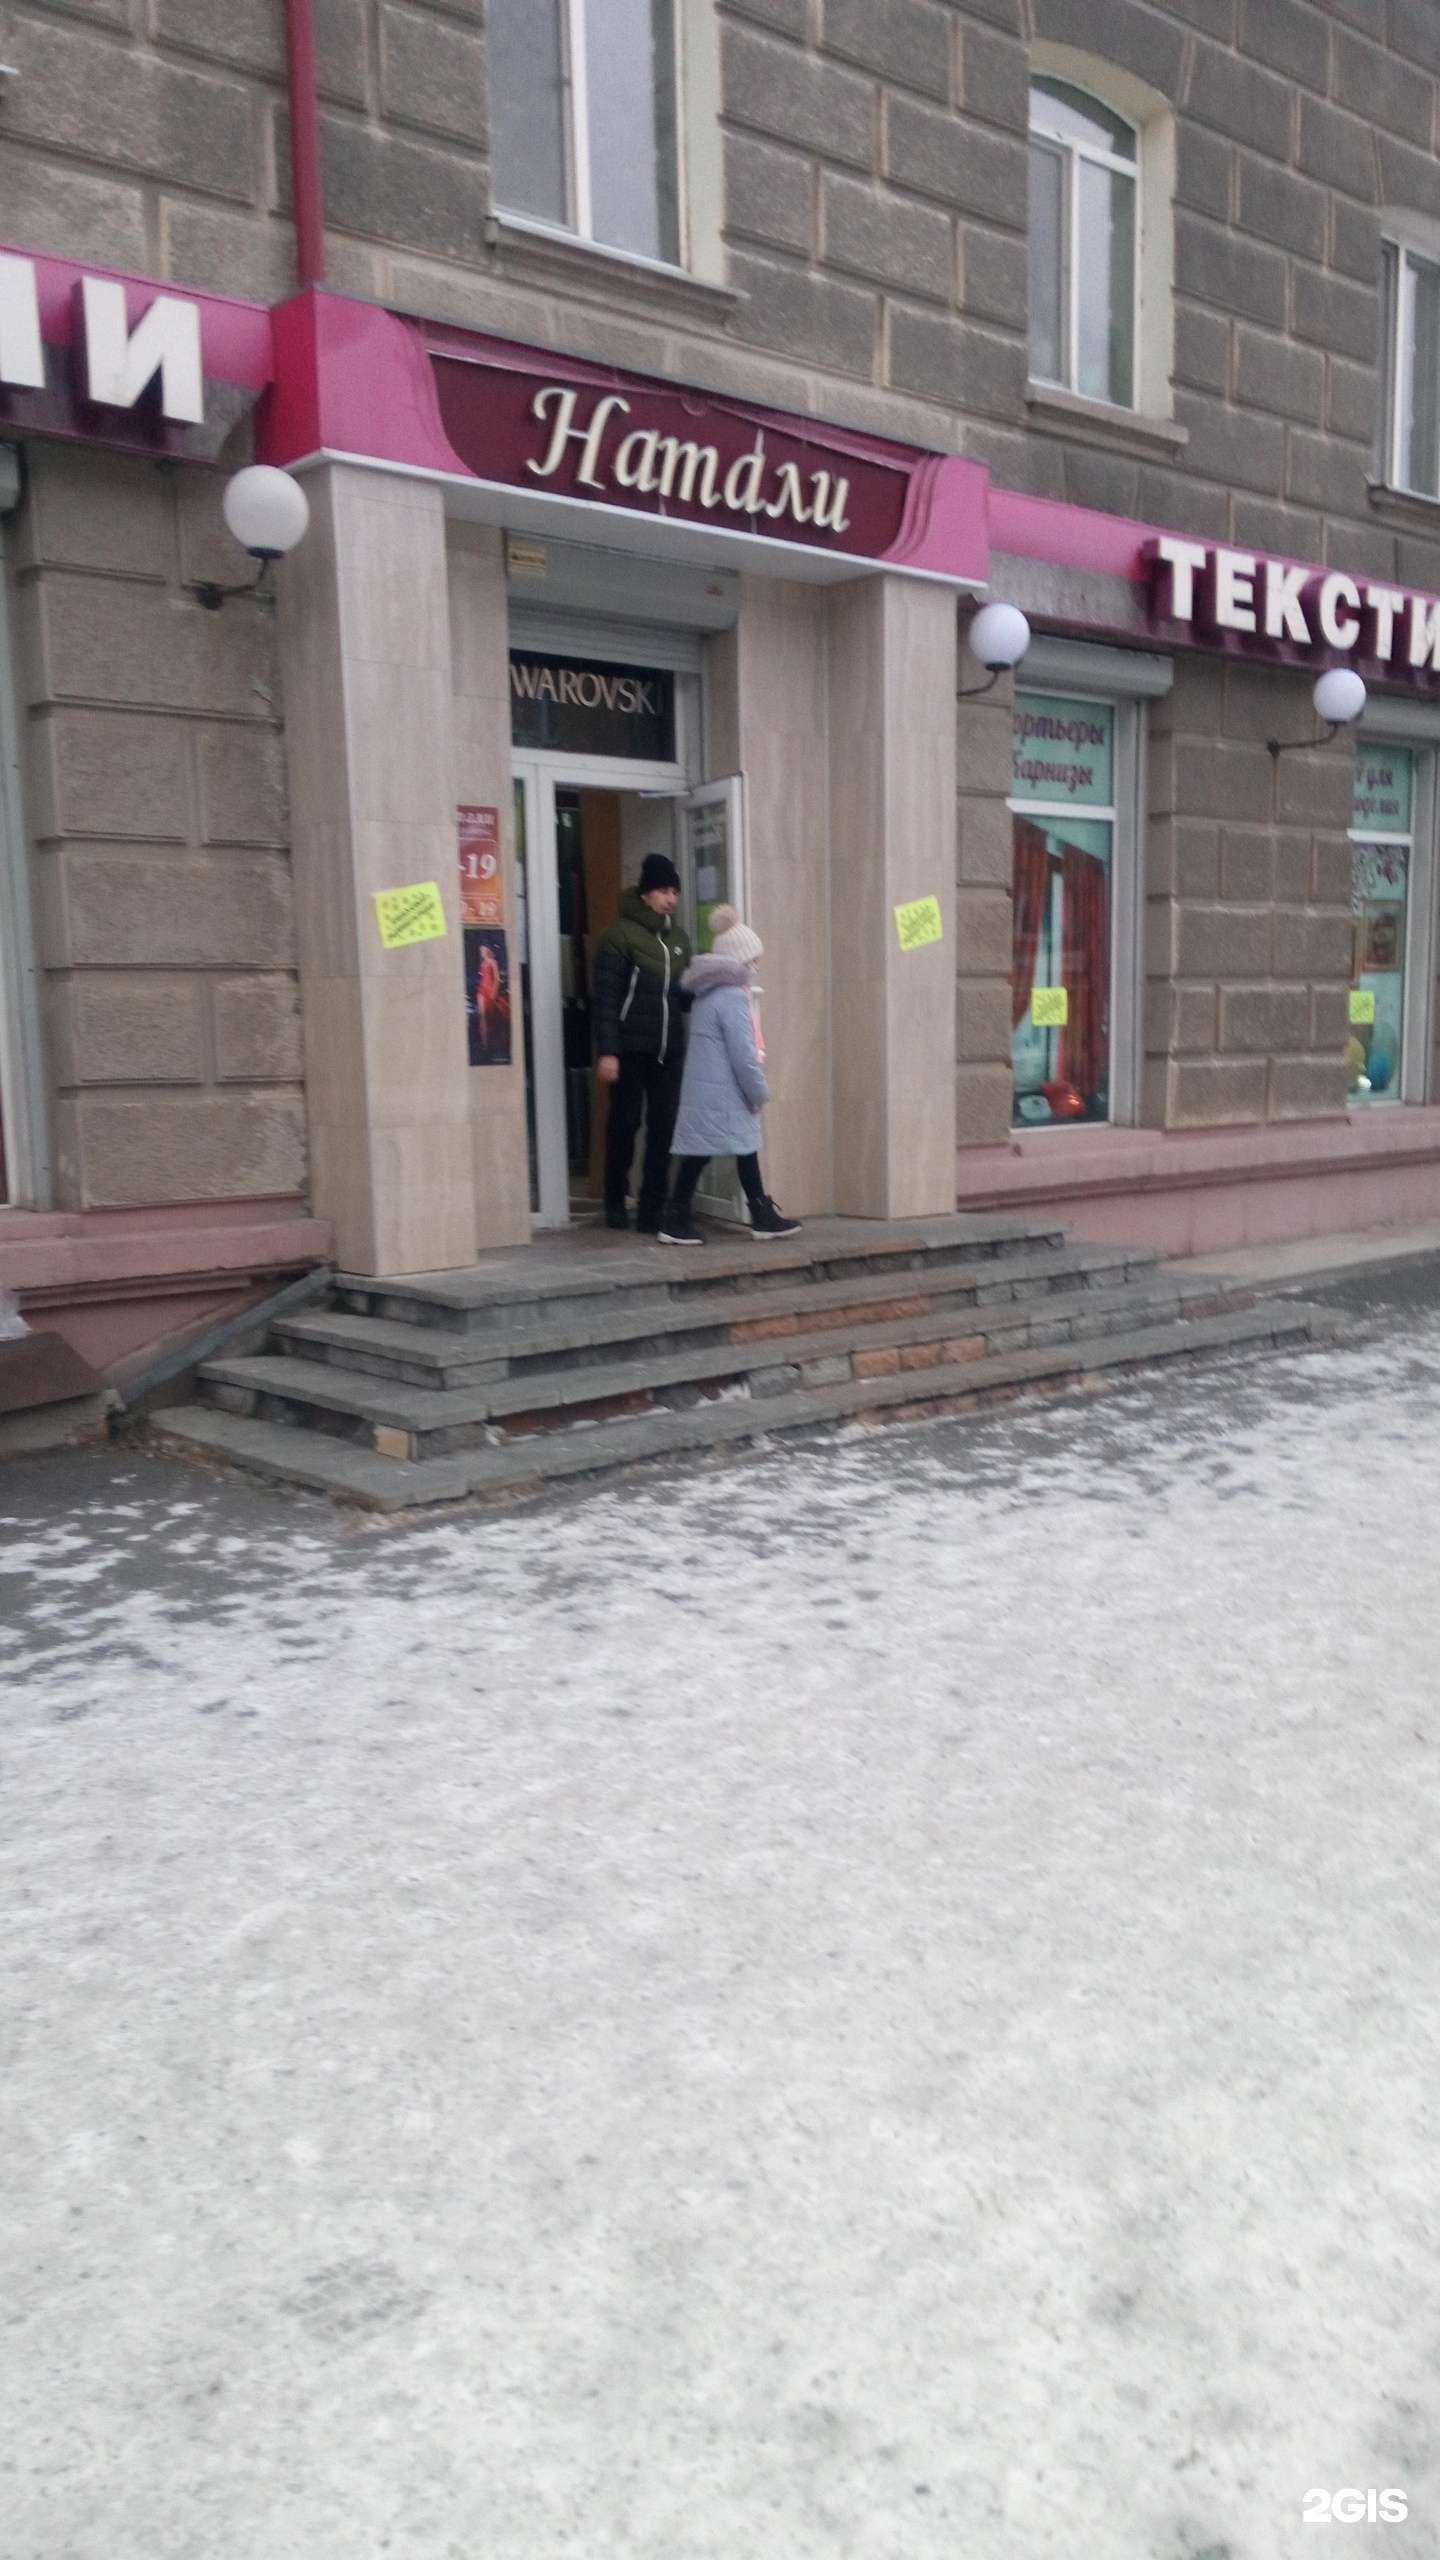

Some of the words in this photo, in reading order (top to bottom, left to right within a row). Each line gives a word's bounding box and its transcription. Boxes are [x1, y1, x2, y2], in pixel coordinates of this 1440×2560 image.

[526, 386, 850, 534] Натали
[1159, 536, 1440, 672] ТЕКСТИ
[509, 664, 665, 716] WAROVSK
